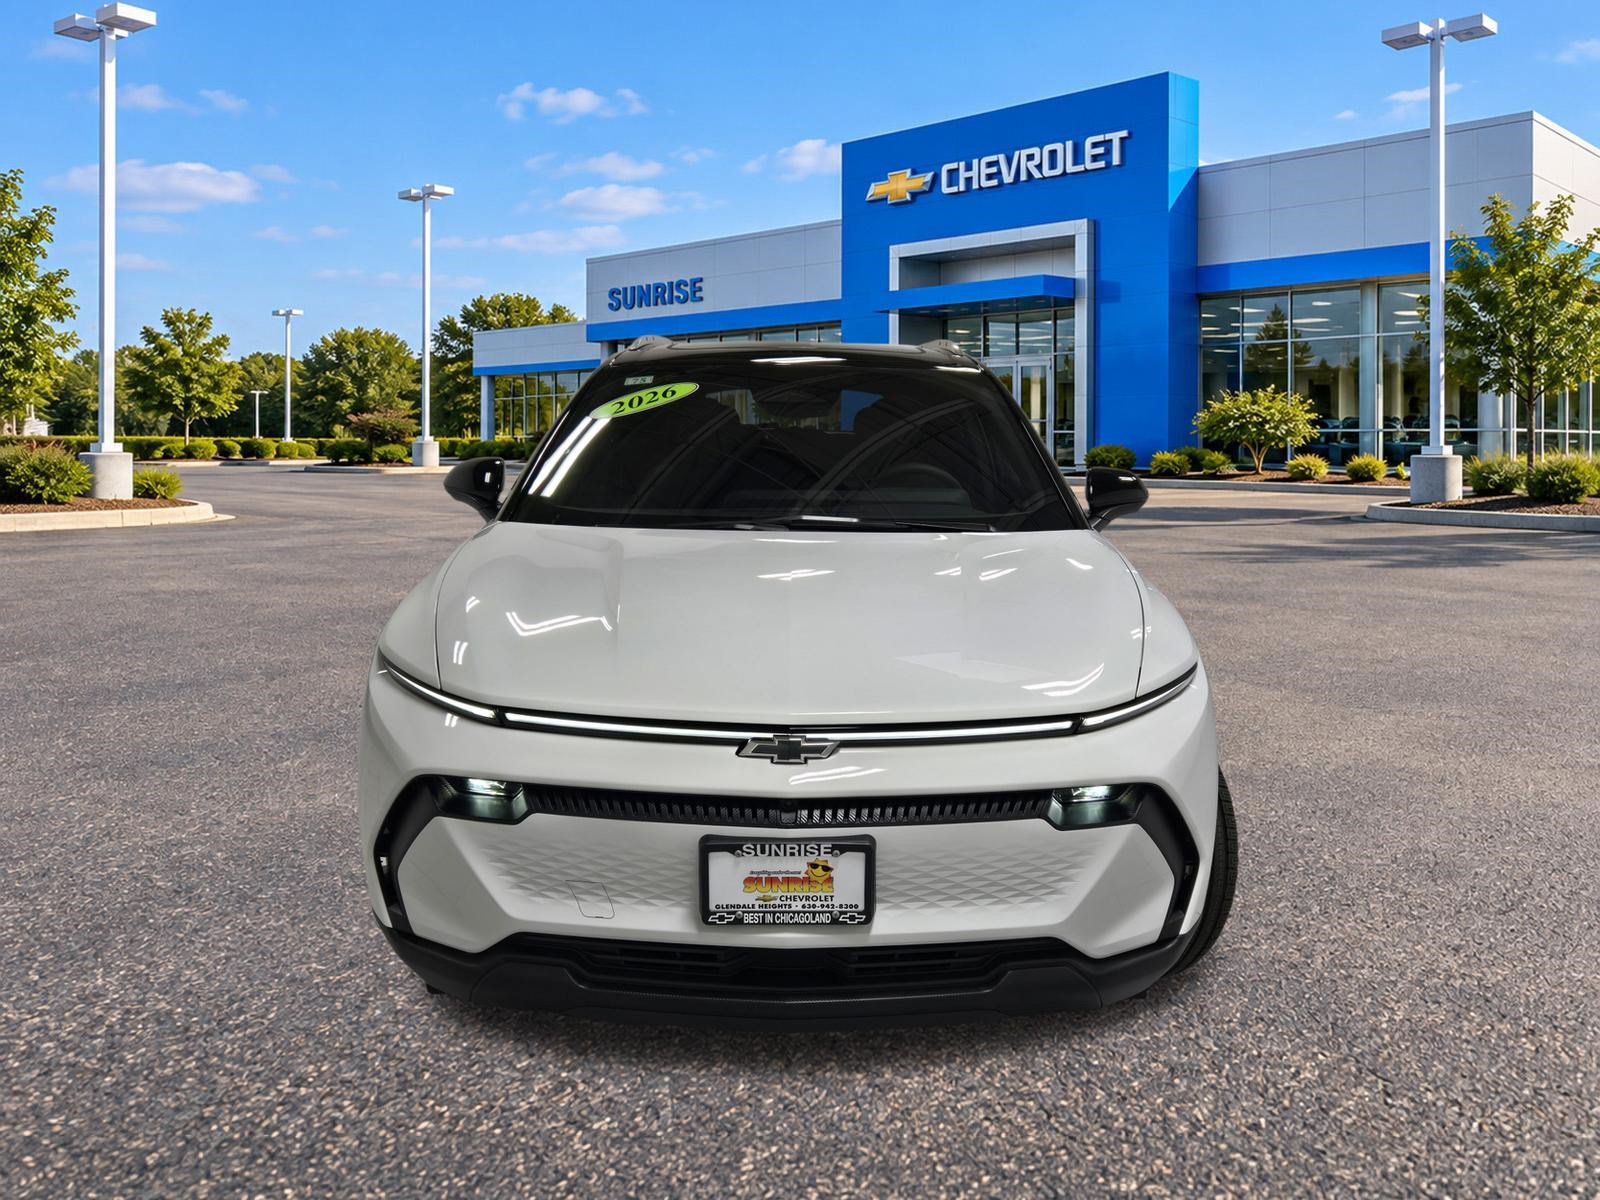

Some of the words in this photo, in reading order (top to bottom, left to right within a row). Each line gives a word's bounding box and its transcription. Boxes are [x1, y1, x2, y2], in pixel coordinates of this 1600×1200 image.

[941, 129, 1129, 194] CHEVROLET
[608, 277, 704, 311] SUNRISE
[611, 386, 676, 415] 2026
[742, 843, 833, 857] SUNRISE
[743, 876, 834, 893] SUNRISE
[779, 894, 834, 902] CHEVROLET
[743, 913, 763, 924] BEST
[765, 913, 773, 924] IN
[775, 913, 831, 924] CHICAGOLAND
